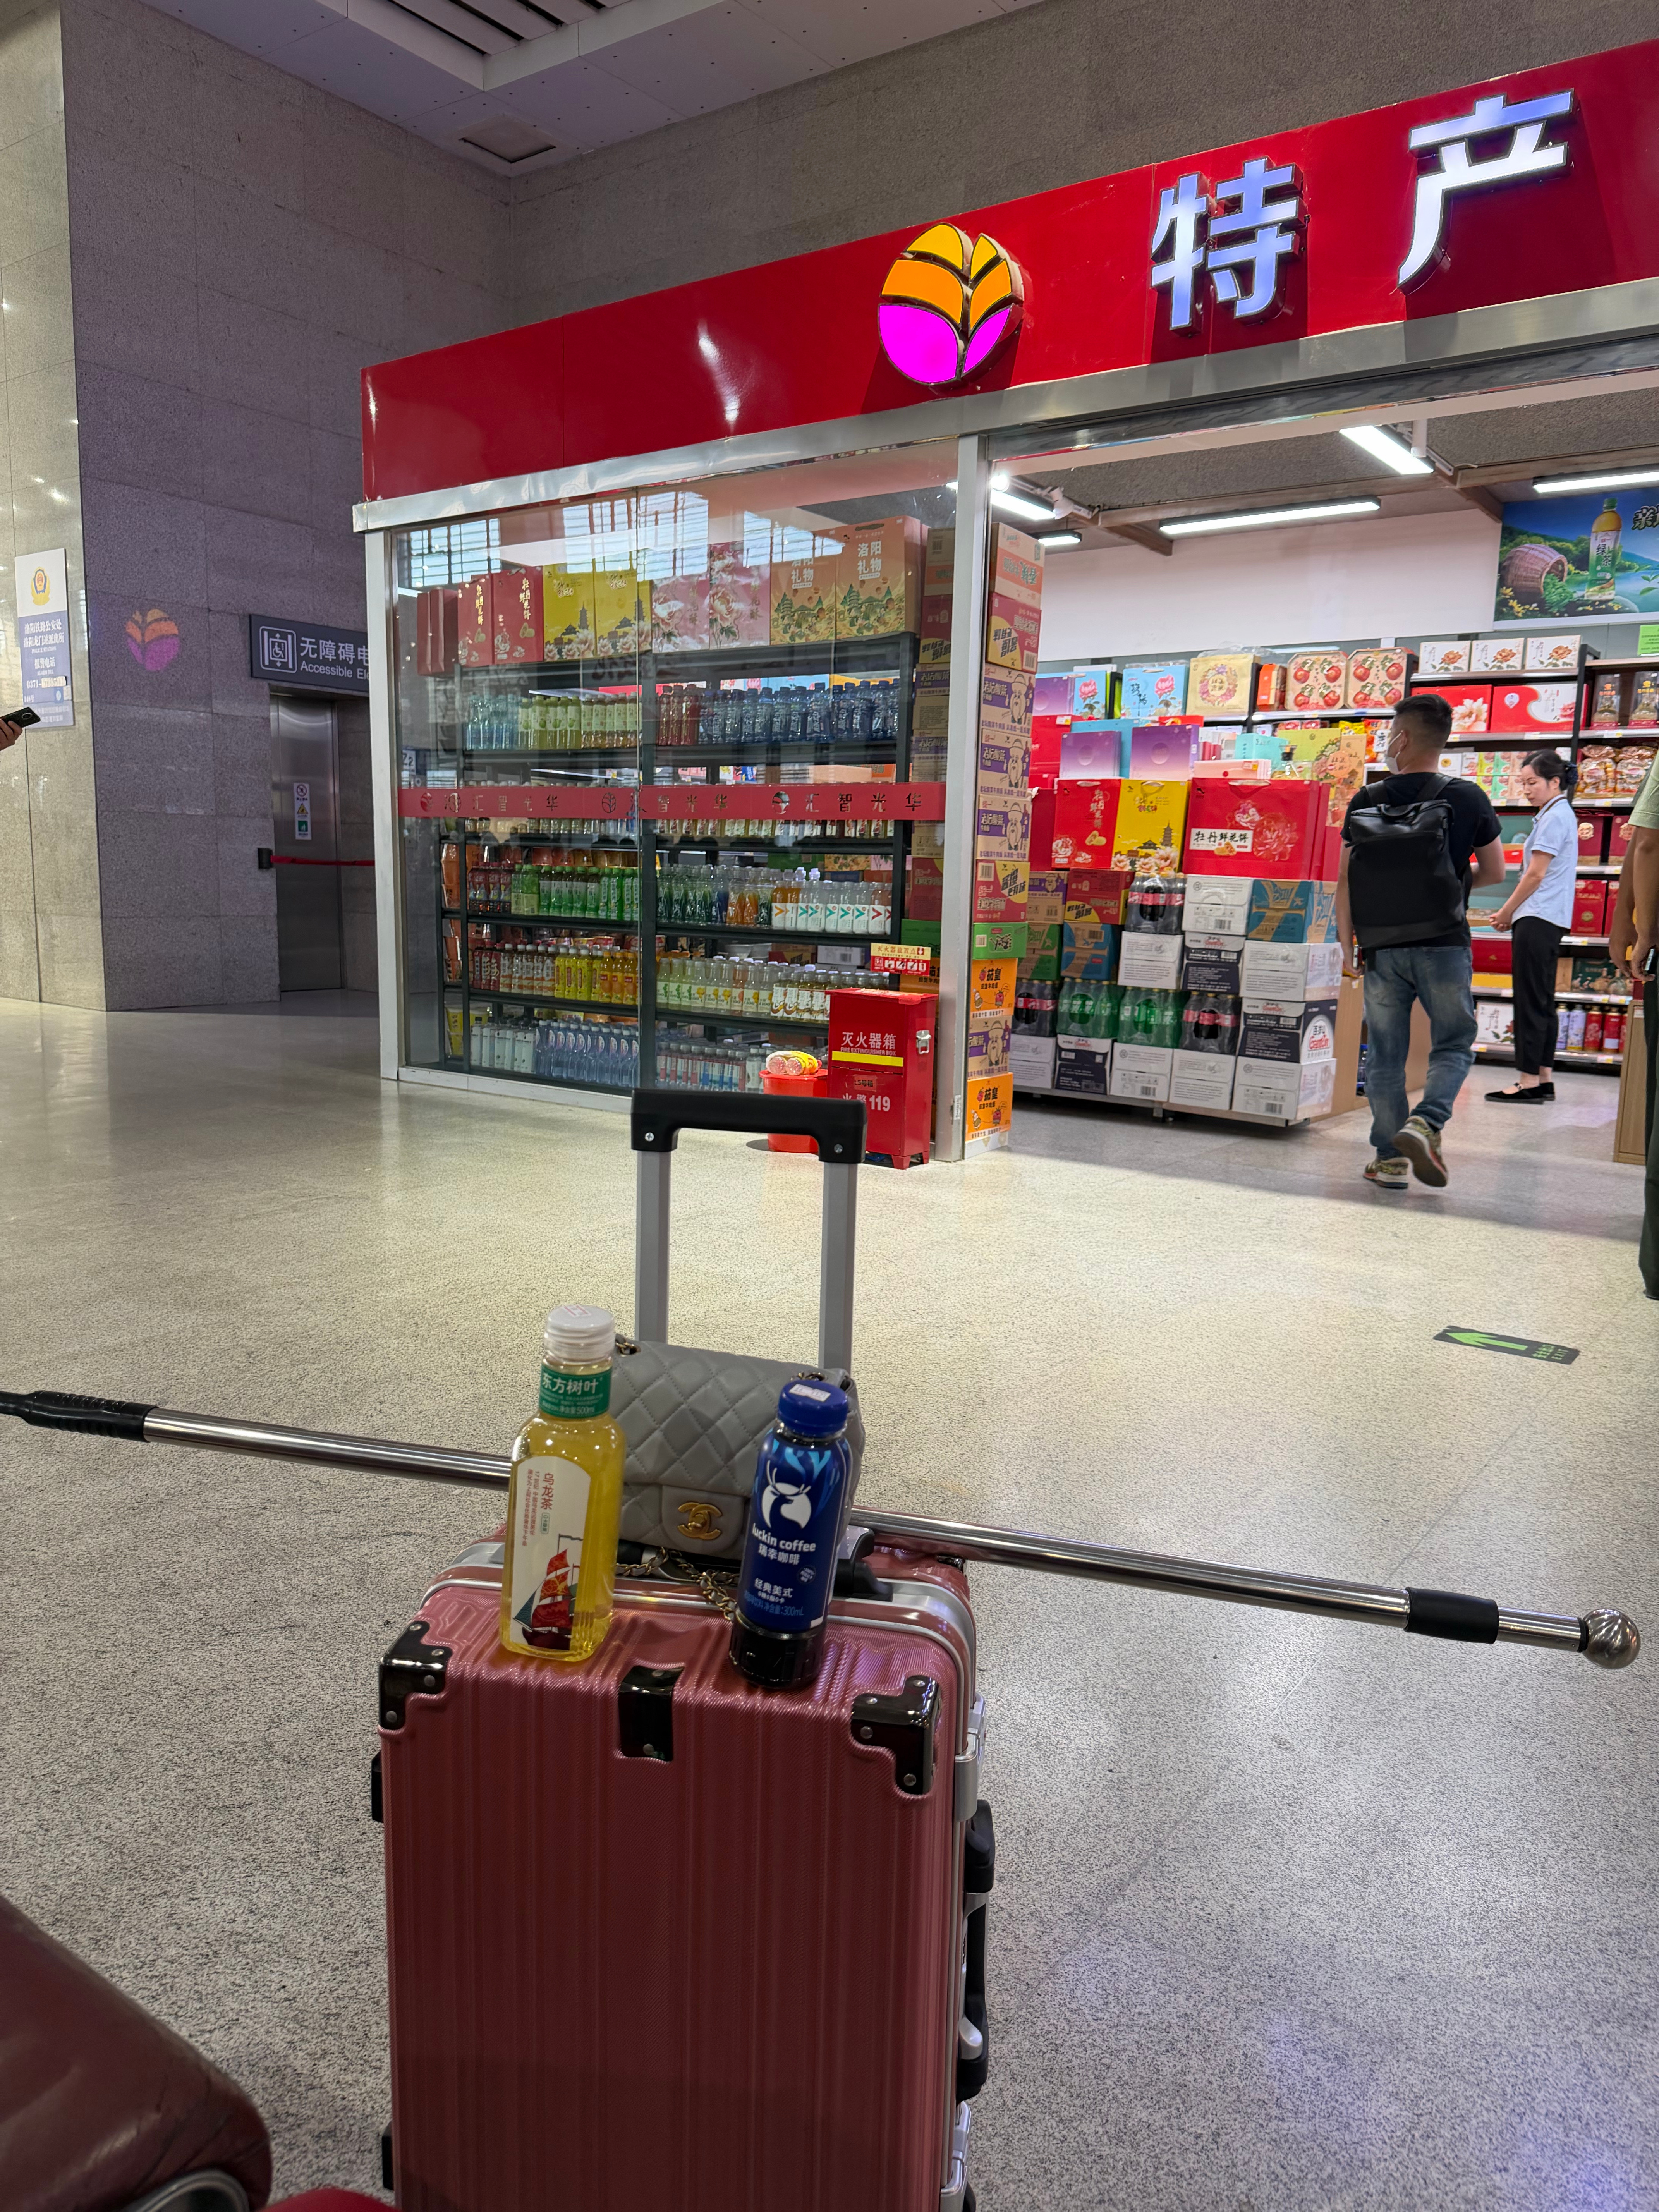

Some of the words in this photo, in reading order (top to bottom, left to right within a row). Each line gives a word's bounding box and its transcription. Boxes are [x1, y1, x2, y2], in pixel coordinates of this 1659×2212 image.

[1151, 88, 1581, 338] 特产
[1632, 504, 1659, 530] 亲
[858, 541, 881, 557] 洛阳
[791, 568, 814, 583] 礼物
[857, 558, 882, 574] 礼物
[300, 637, 369, 666] 无障碍电
[301, 660, 353, 678] Accessible
[805, 792, 922, 812] 汇智光华
[1194, 831, 1249, 843] 牡丹鲜花饼
[841, 1032, 896, 1050] 灭火器箱
[851, 1047, 885, 1056] EXTINGUISHER
[869, 1095, 891, 1112] 119
[543, 1372, 599, 1395] 东方树叶
[541, 1472, 555, 1510] 乌龙茶
[752, 1522, 777, 1547] luckin
[779, 1539, 816, 1552] coffee
[758, 1543, 800, 1566] 瑞幸咖啡
[754, 1577, 793, 1598] 经典美式
